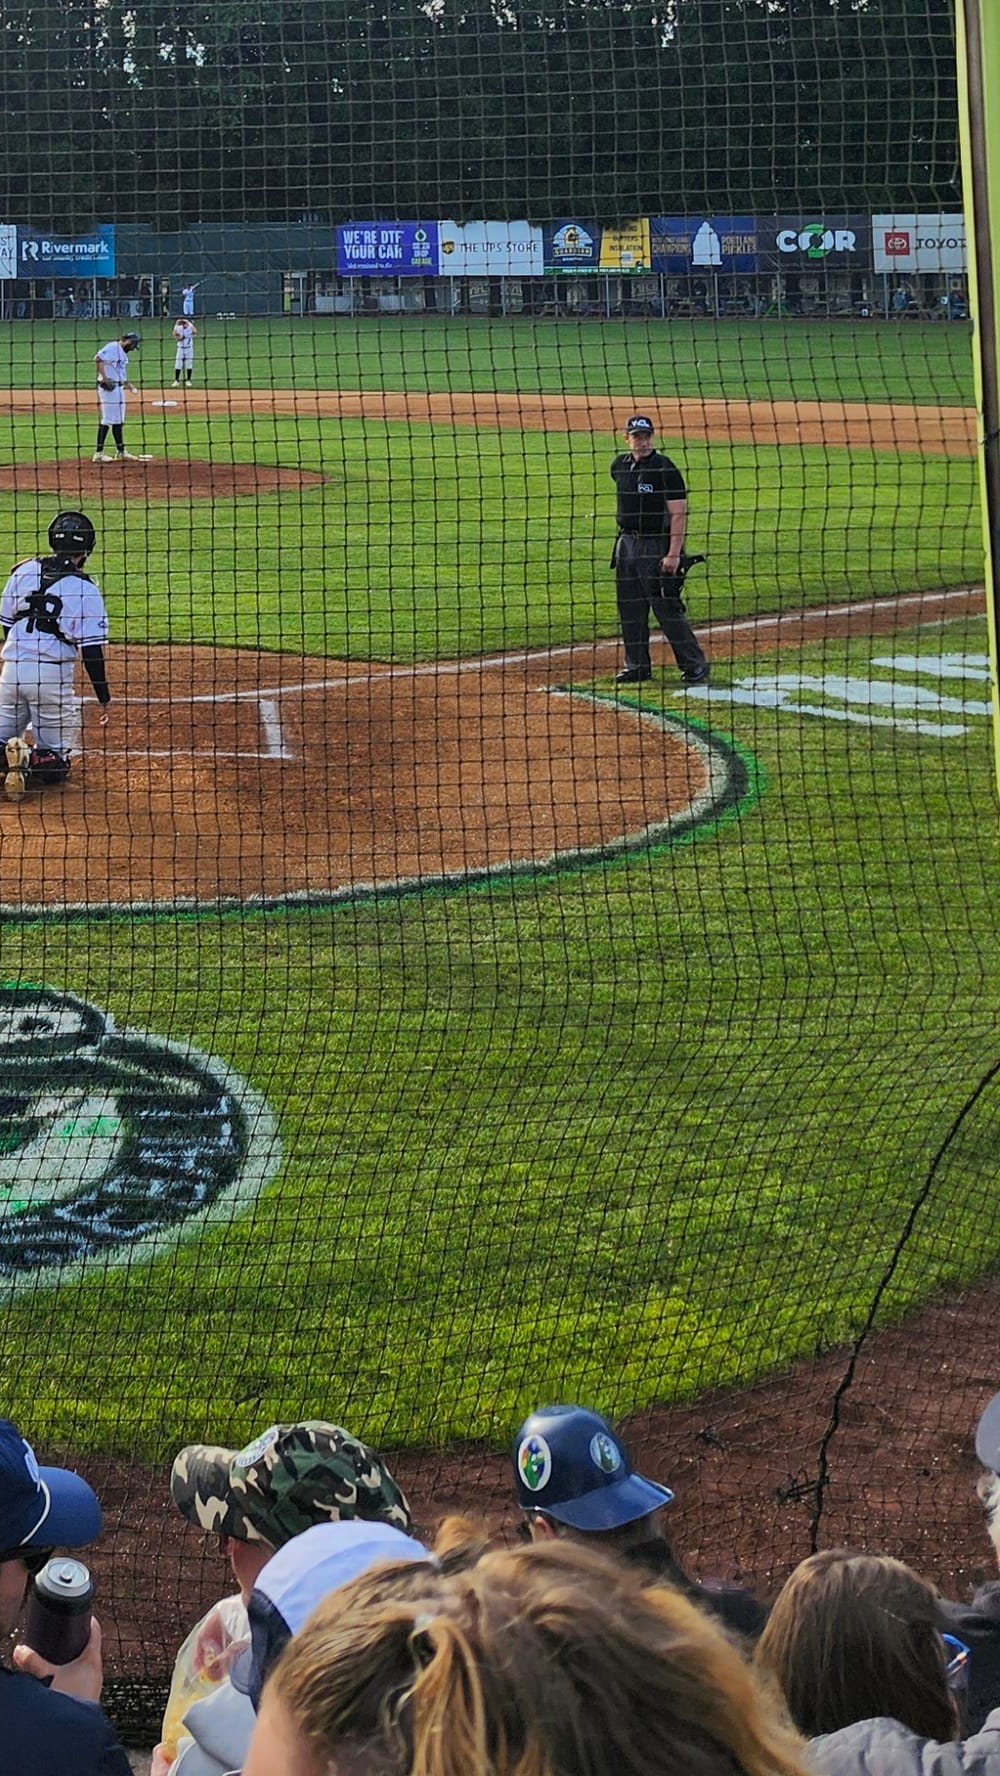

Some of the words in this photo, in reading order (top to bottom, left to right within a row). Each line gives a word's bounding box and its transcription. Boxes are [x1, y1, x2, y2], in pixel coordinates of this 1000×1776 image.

[343, 230, 378, 244] WE'RE
[916, 238, 967, 249] TOYOT
[41, 240, 110, 254] Rivermark
[344, 244, 376, 259] YOUR
[378, 244, 403, 259] CAR
[460, 243, 478, 253] THE
[482, 242, 502, 253] UPS
[505, 242, 539, 253] STORE
